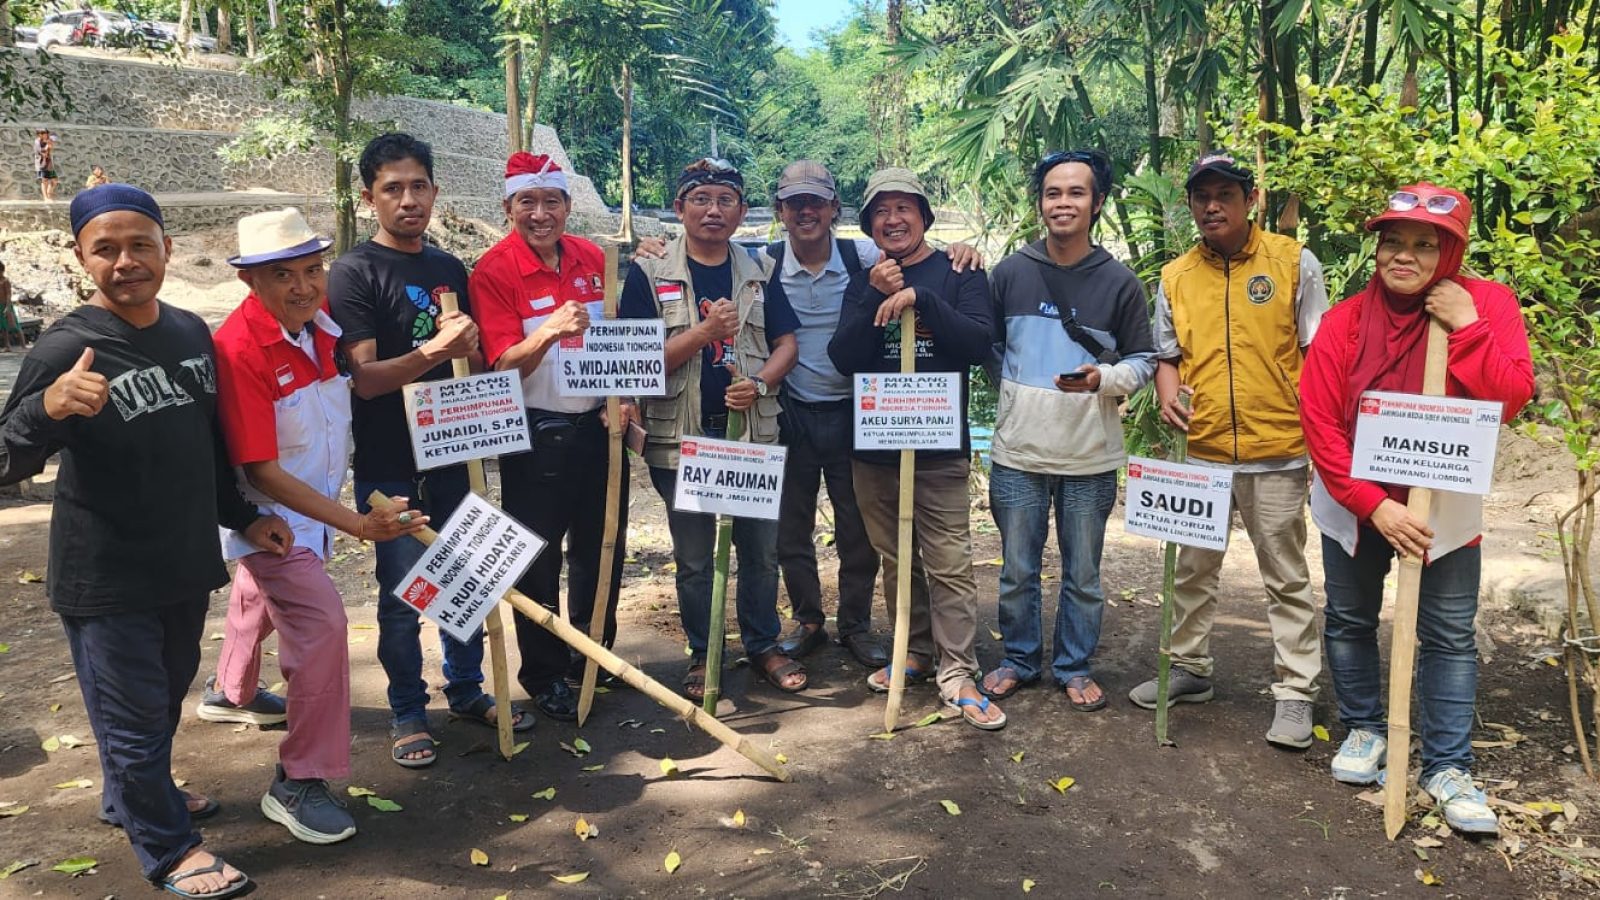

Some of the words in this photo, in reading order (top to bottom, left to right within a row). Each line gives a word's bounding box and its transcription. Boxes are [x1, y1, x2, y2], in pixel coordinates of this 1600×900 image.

[590, 326, 657, 336] PERHIMPUNAN
[587, 342, 624, 352] INDONESIA
[627, 342, 662, 351] TIONGHOA
[564, 361, 575, 375] S.
[580, 360, 662, 375] WIDJANARKO
[440, 375, 509, 390] MOLANG
[567, 378, 610, 389] WAKIL
[615, 378, 659, 389] KETUA
[439, 413, 479, 424] INDONESIA
[481, 405, 519, 417] TIONGHOA
[440, 397, 513, 416] PERHIMPUNAN
[422, 423, 488, 443] JUNAIDI,
[492, 417, 524, 430] S.Pd
[861, 417, 887, 425] AKEU
[891, 417, 923, 425] SURYA
[926, 416, 953, 425] PANJI
[425, 443, 470, 458] KETUA
[473, 433, 524, 449] PANITIA
[1382, 436, 1470, 457] MANSUR
[1374, 454, 1410, 465] IKATAN
[1413, 459, 1470, 472] KELUARGA
[683, 465, 711, 484] RAY
[715, 470, 777, 491] ARUMAN
[1369, 465, 1430, 479] BANYUWANGI
[1432, 474, 1472, 484] LOMBOK
[684, 489, 722, 499] SEKJEN
[1140, 490, 1213, 518] SAUDI
[1136, 511, 1170, 523] KETUA
[1174, 519, 1215, 531] FORUM
[426, 506, 483, 575] PERHIMPUNAN
[1128, 520, 1168, 532] WARTAWAN
[1170, 528, 1223, 542] LINGKUNGAN
[438, 548, 473, 589] INDONESIA
[469, 512, 501, 550] TIONGHOA
[438, 610, 457, 623] H.
[451, 576, 481, 608] RUDI
[475, 524, 519, 577] HIDAYAT
[454, 599, 484, 629] WAKIL
[480, 540, 527, 598] SEKRETARIS
